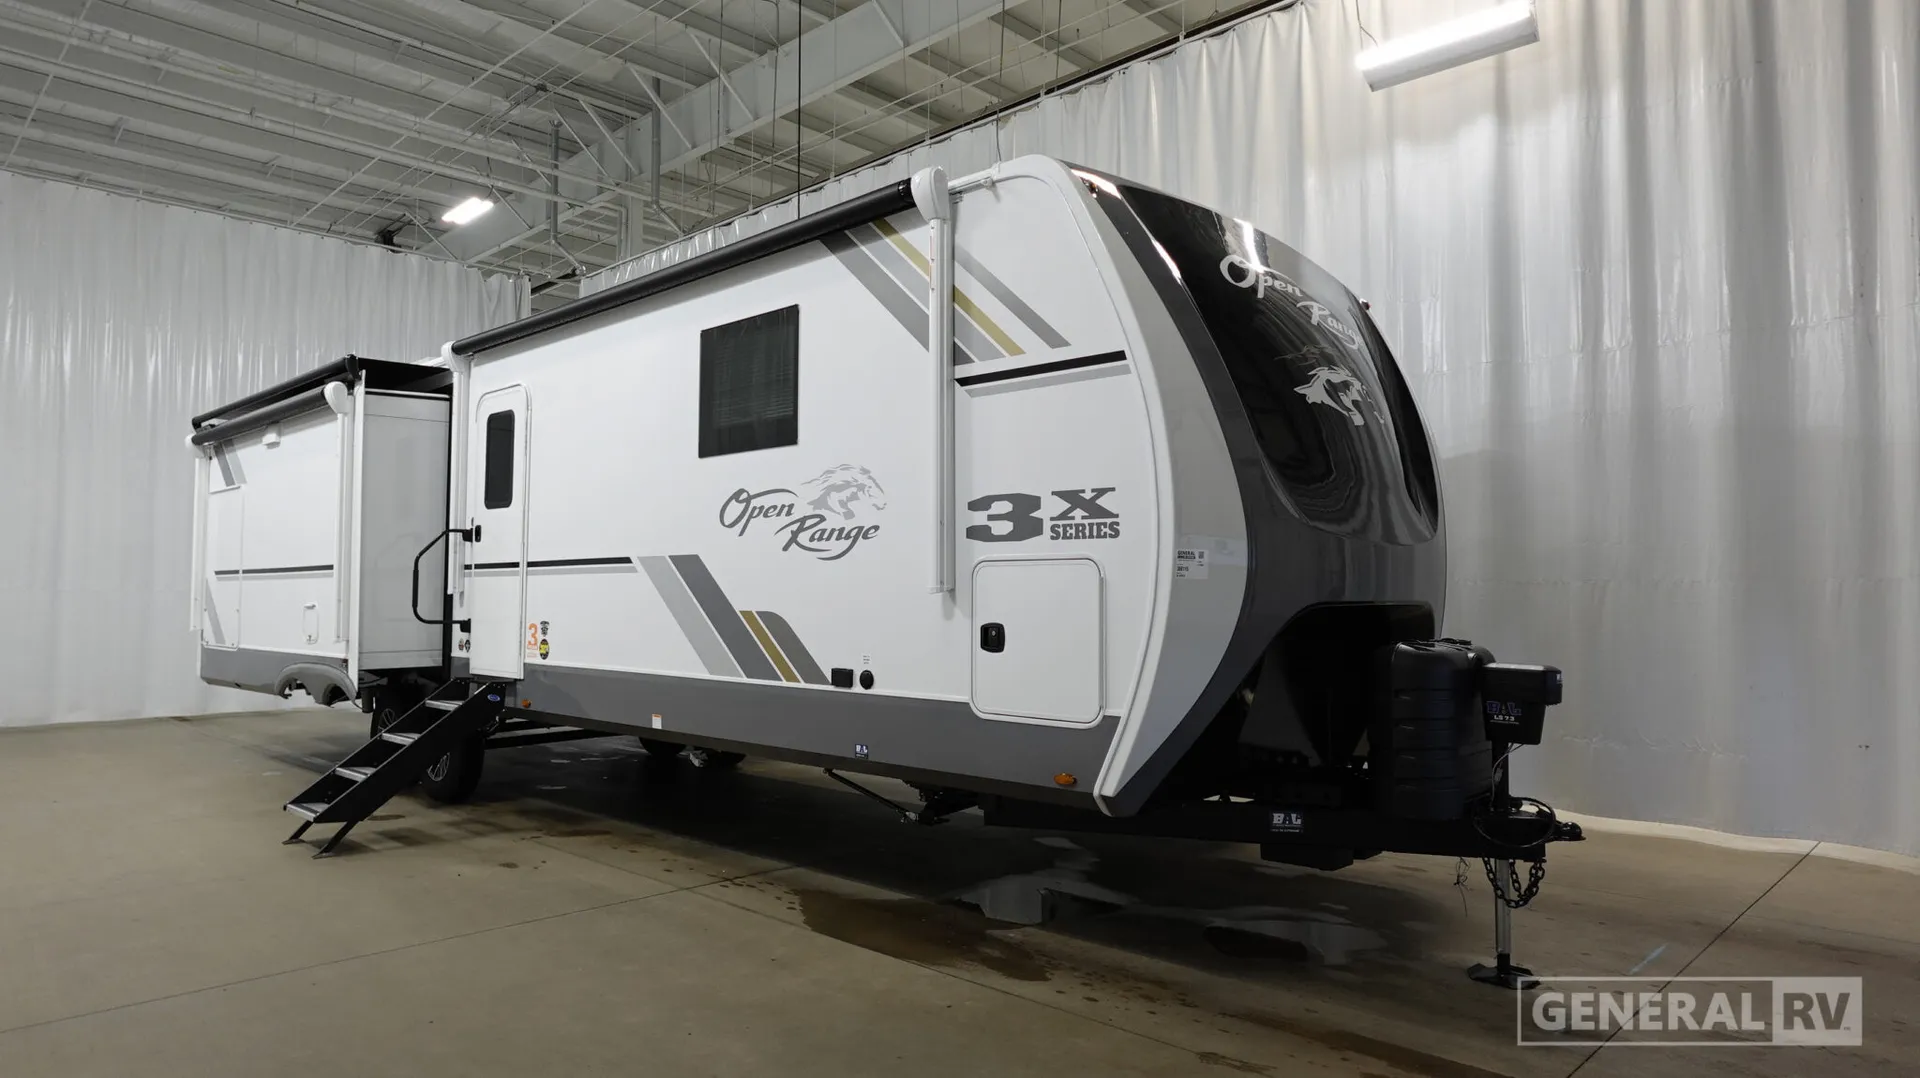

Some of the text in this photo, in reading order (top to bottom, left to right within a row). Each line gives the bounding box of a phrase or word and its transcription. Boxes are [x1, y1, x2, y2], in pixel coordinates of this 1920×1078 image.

[1220, 254, 1303, 299] Open
[719, 488, 799, 536] Open
[966, 493, 1044, 543] 3
[1050, 521, 1120, 540] SERIES
[774, 514, 880, 561] Range
